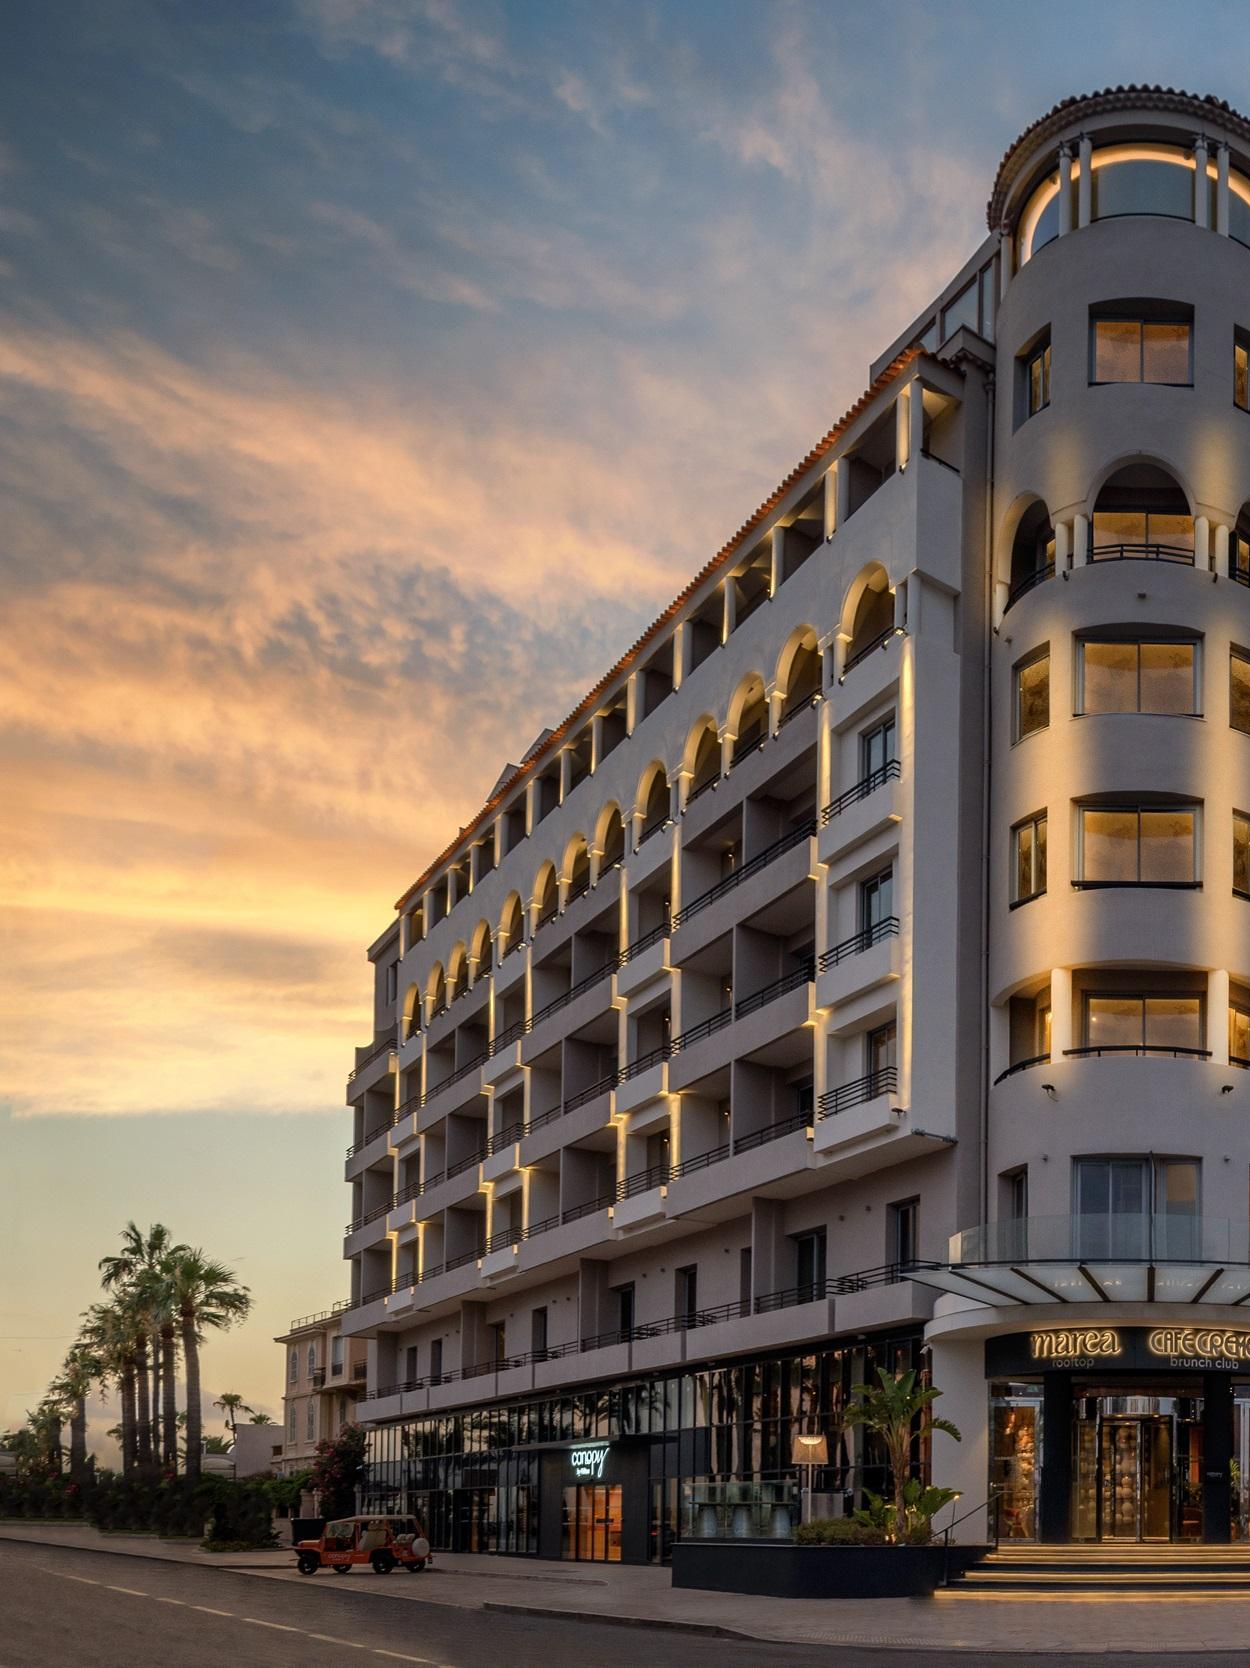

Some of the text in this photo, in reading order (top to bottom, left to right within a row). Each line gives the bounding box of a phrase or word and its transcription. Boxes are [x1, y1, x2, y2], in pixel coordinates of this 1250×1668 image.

[1032, 1330, 1121, 1357] marea
[1052, 1357, 1095, 1369] rooftop
[1170, 1354, 1239, 1370] brunch club
[571, 1447, 610, 1478] canopy
